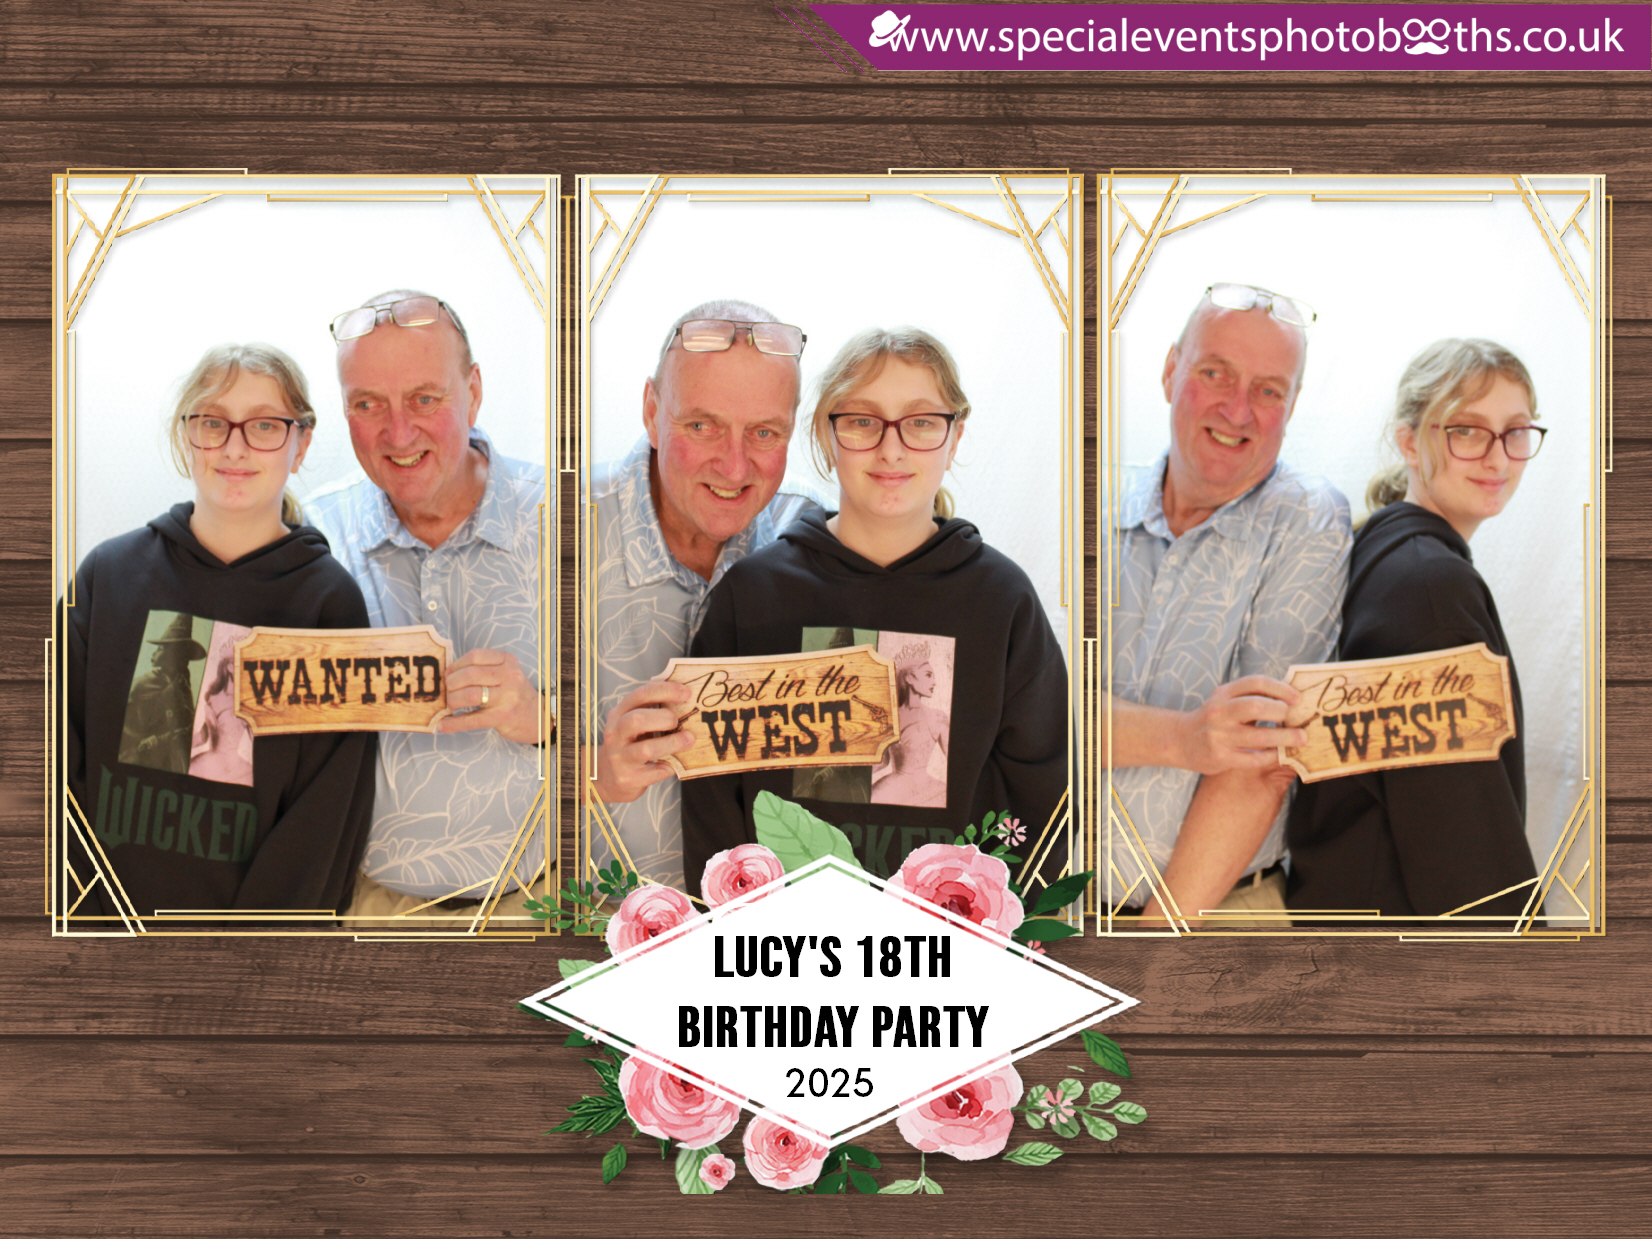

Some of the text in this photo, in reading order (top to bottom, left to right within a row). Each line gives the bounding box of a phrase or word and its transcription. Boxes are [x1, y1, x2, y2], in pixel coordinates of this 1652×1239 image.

[243, 655, 442, 706] WANTED
[683, 664, 861, 708] Best in the
[1301, 664, 1475, 712] Best in the
[701, 699, 851, 762] WEST
[1322, 697, 1468, 763] WEST
[95, 764, 258, 862] WICKED
